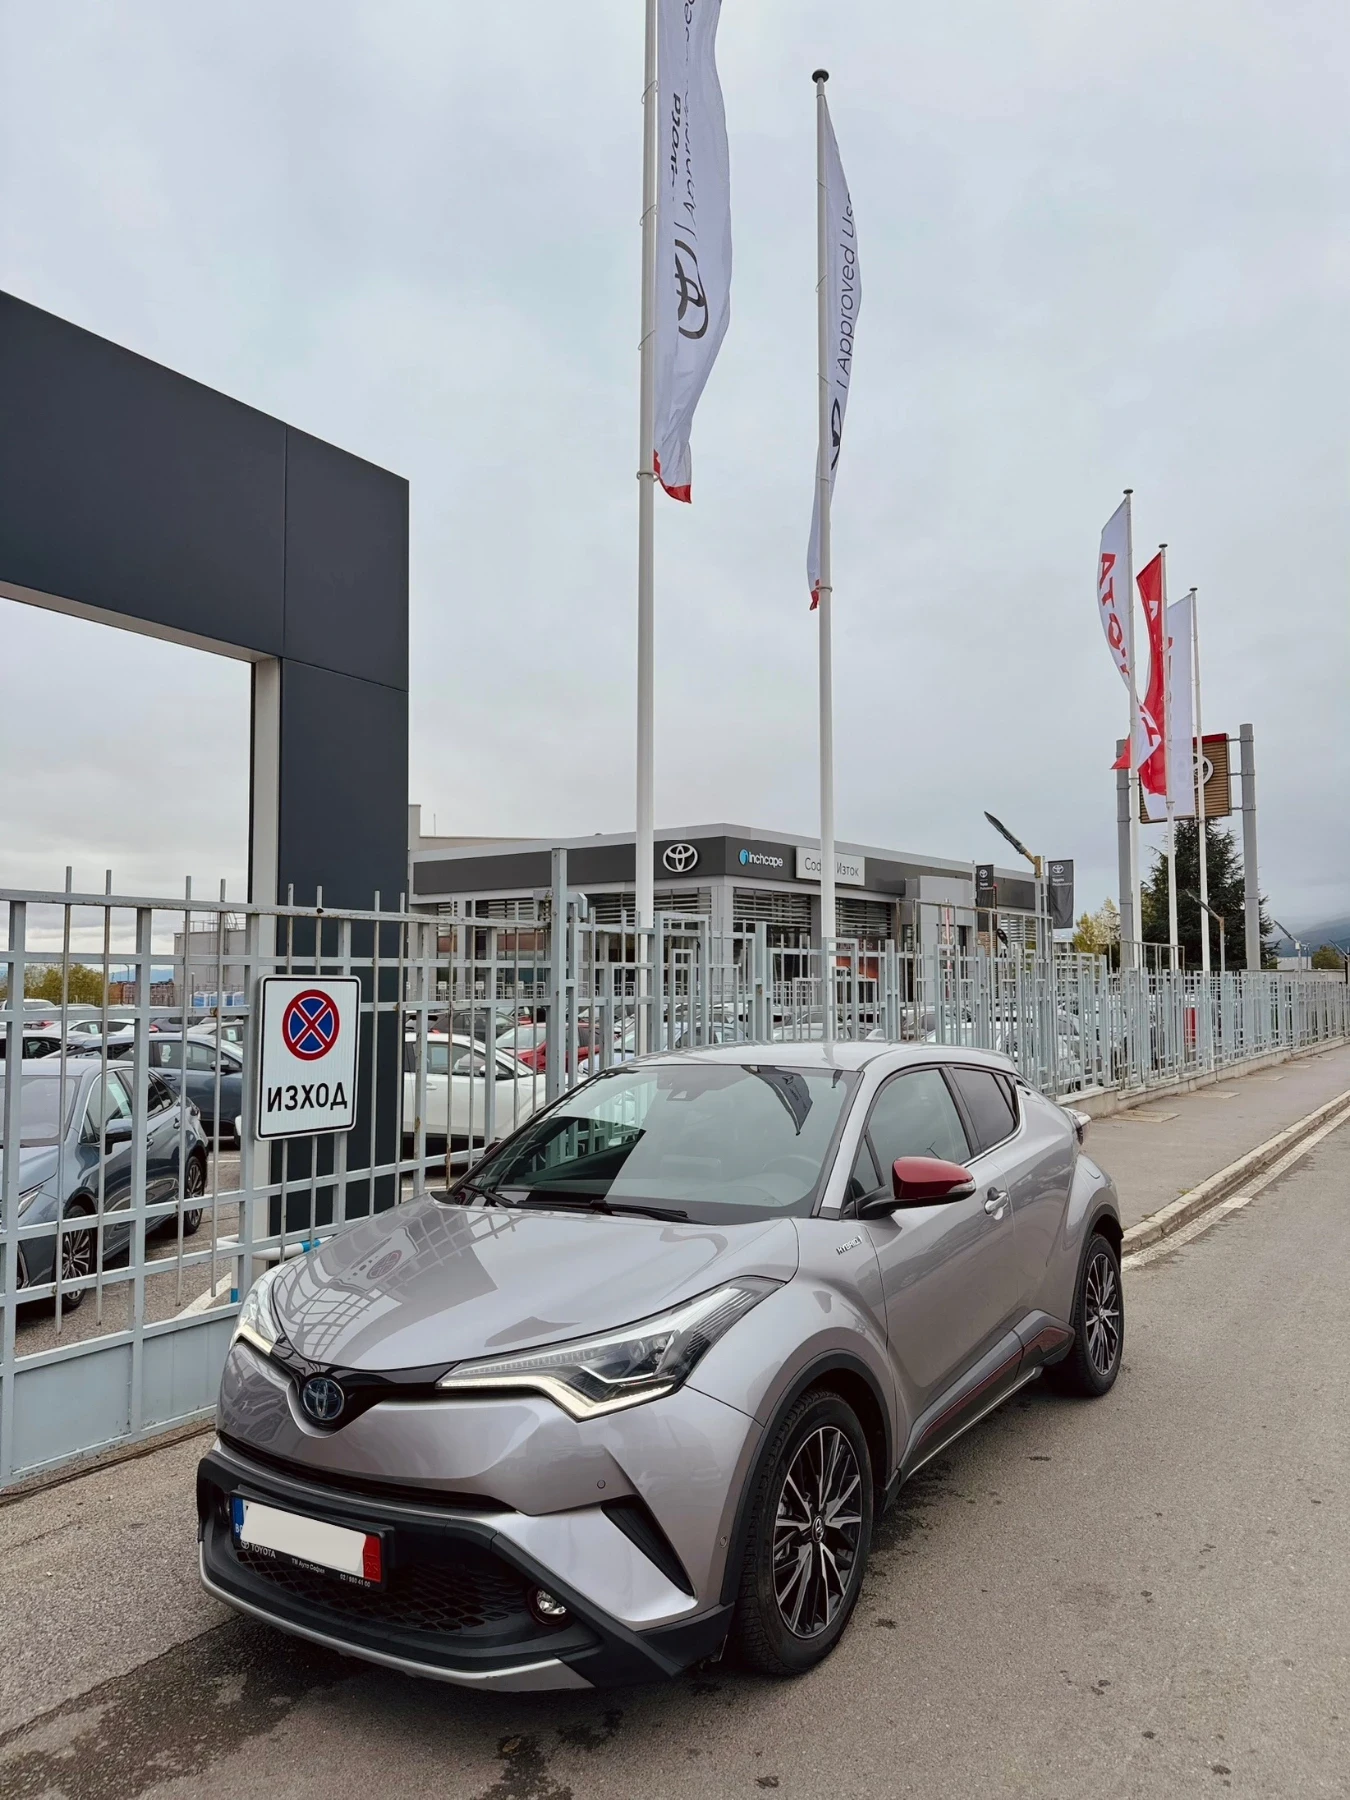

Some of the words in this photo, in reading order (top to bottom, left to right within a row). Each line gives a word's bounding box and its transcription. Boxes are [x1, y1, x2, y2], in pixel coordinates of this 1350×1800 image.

[836, 244, 854, 376] Approved
[804, 857, 822, 875] Соф
[836, 861, 860, 877] Изток
[266, 1081, 348, 1113] ИЗХОД
[250, 1543, 277, 1558] TOYOTA
